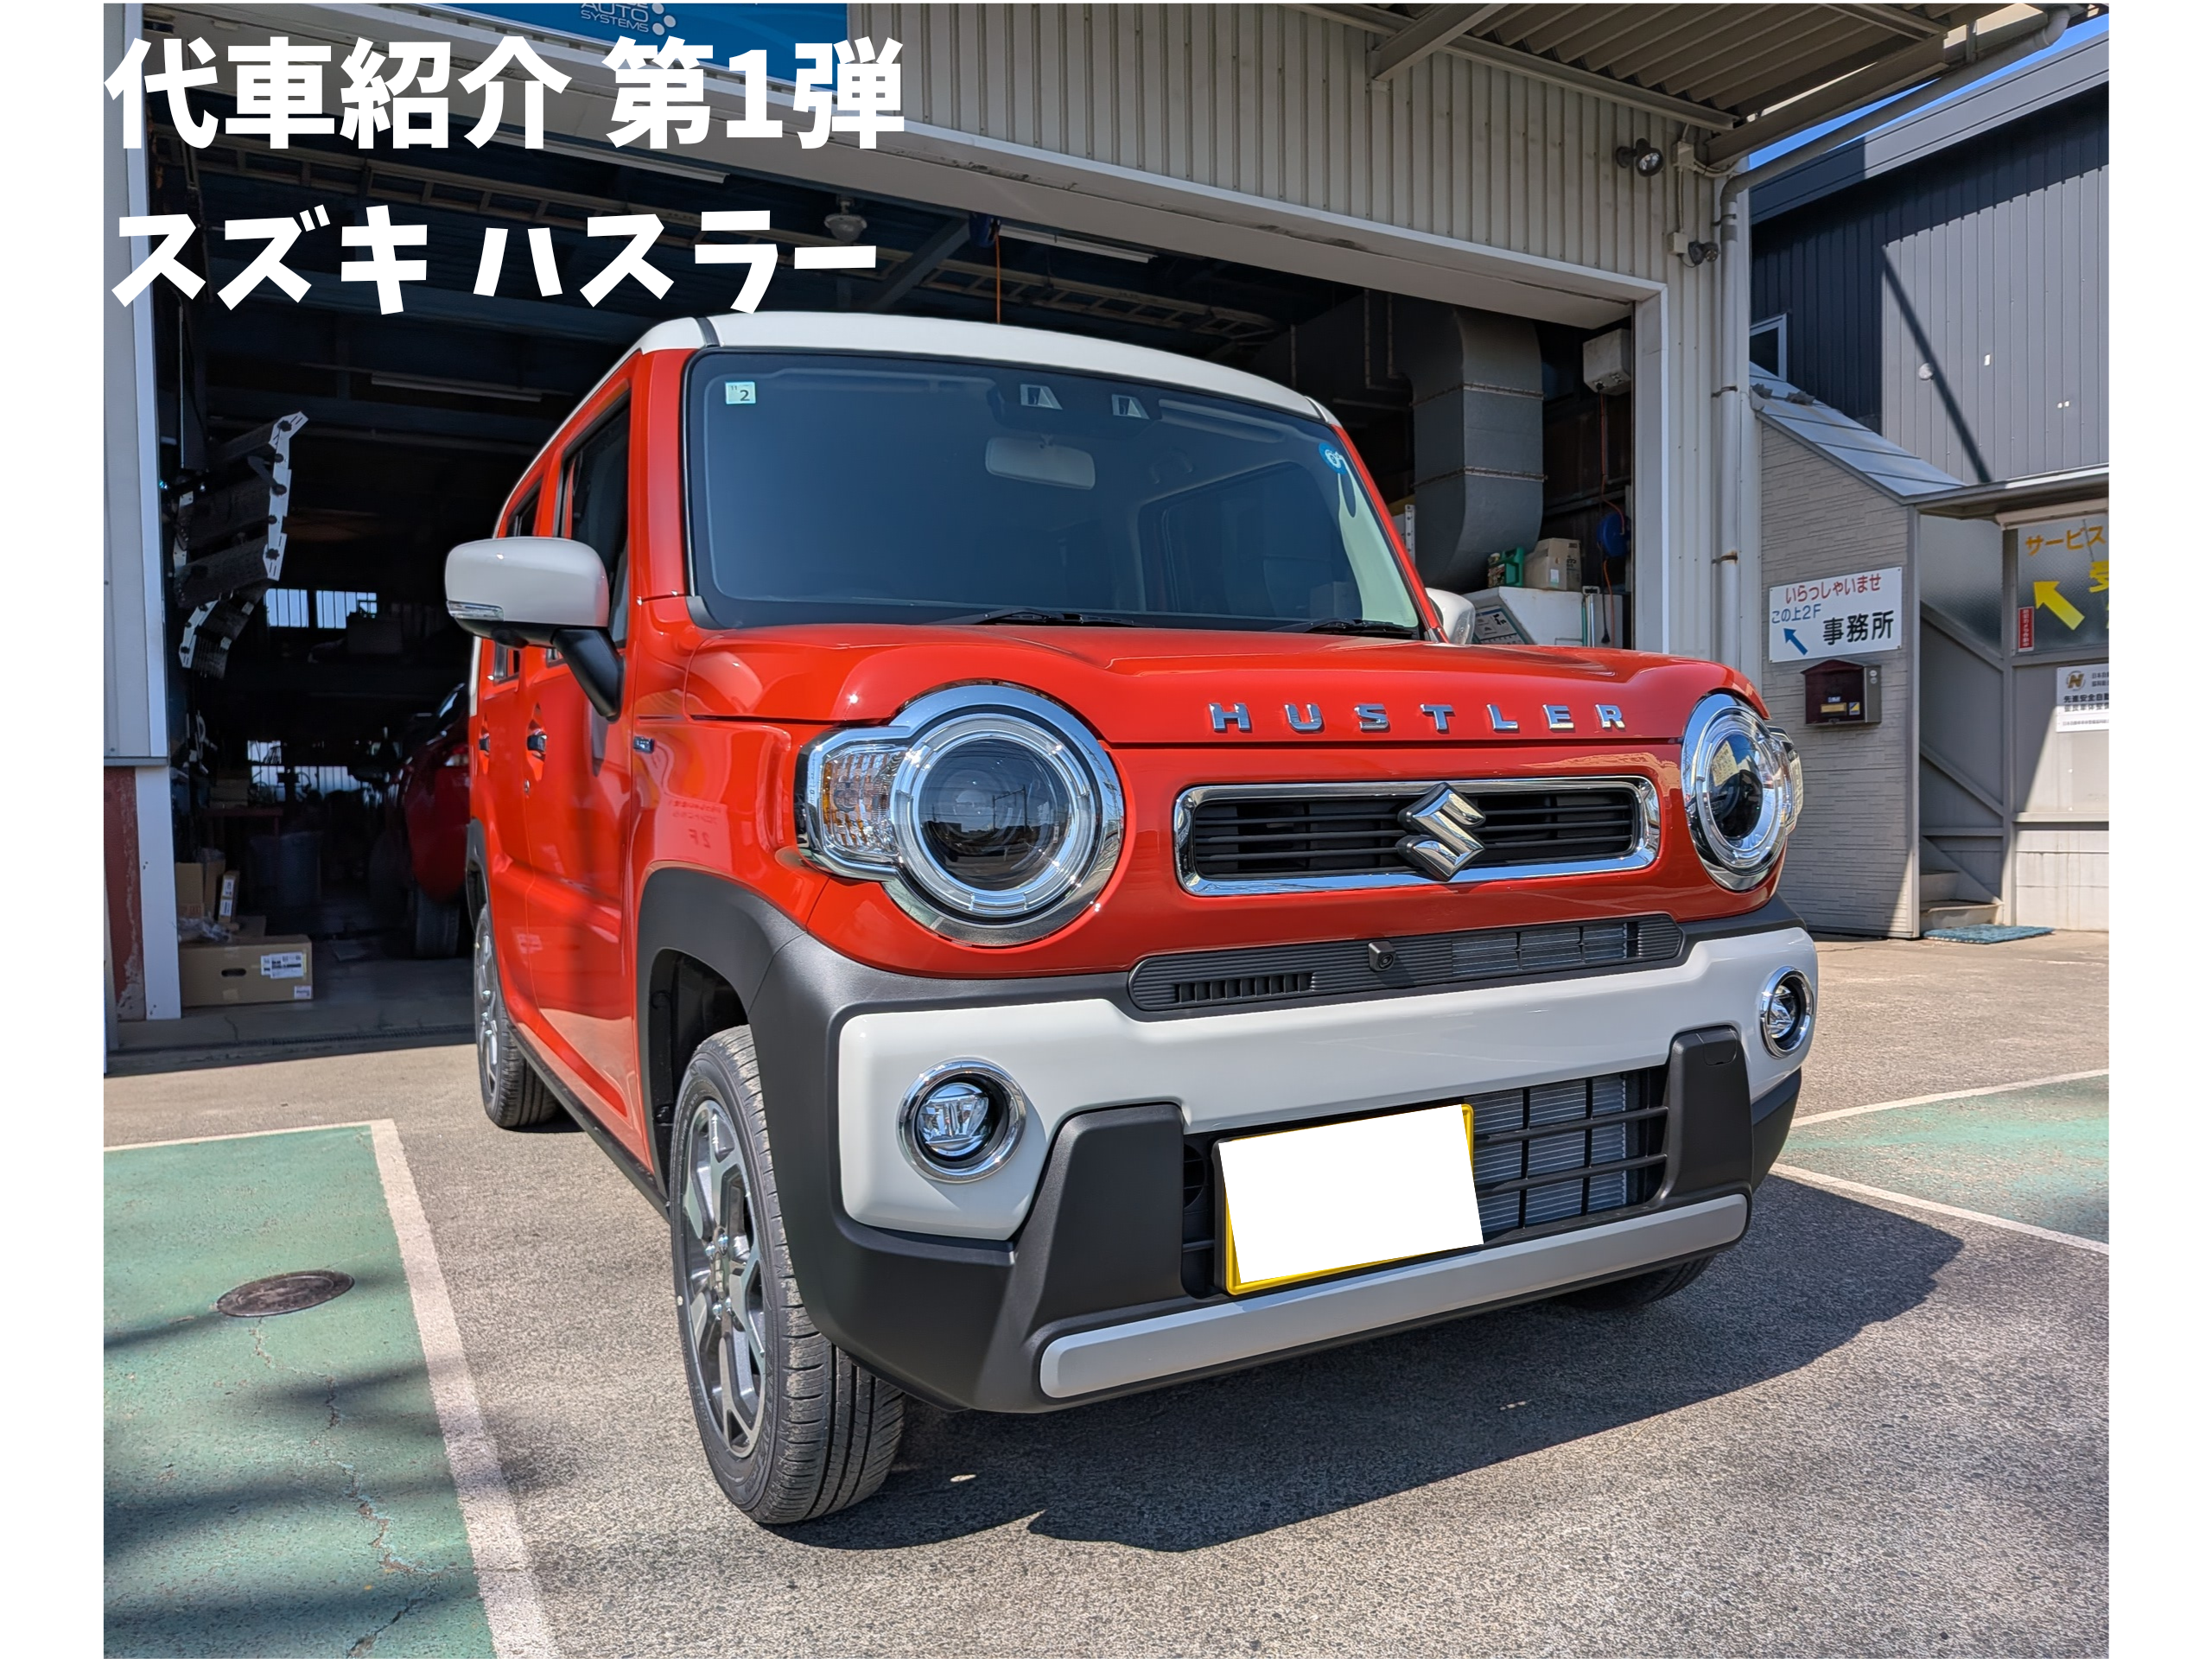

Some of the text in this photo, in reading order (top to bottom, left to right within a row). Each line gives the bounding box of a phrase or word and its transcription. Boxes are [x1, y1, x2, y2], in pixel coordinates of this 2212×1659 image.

[581, 3, 649, 22] AUTO
[581, 10, 649, 33] SYSTEMS
[740, 389, 751, 402] 2
[2024, 524, 2107, 556] サービス
[1785, 573, 1882, 604] いらっしゃいませ
[1771, 603, 1822, 624] この上2F
[1822, 609, 1895, 646] 事務所
[1208, 702, 1627, 733] HUSTLER
